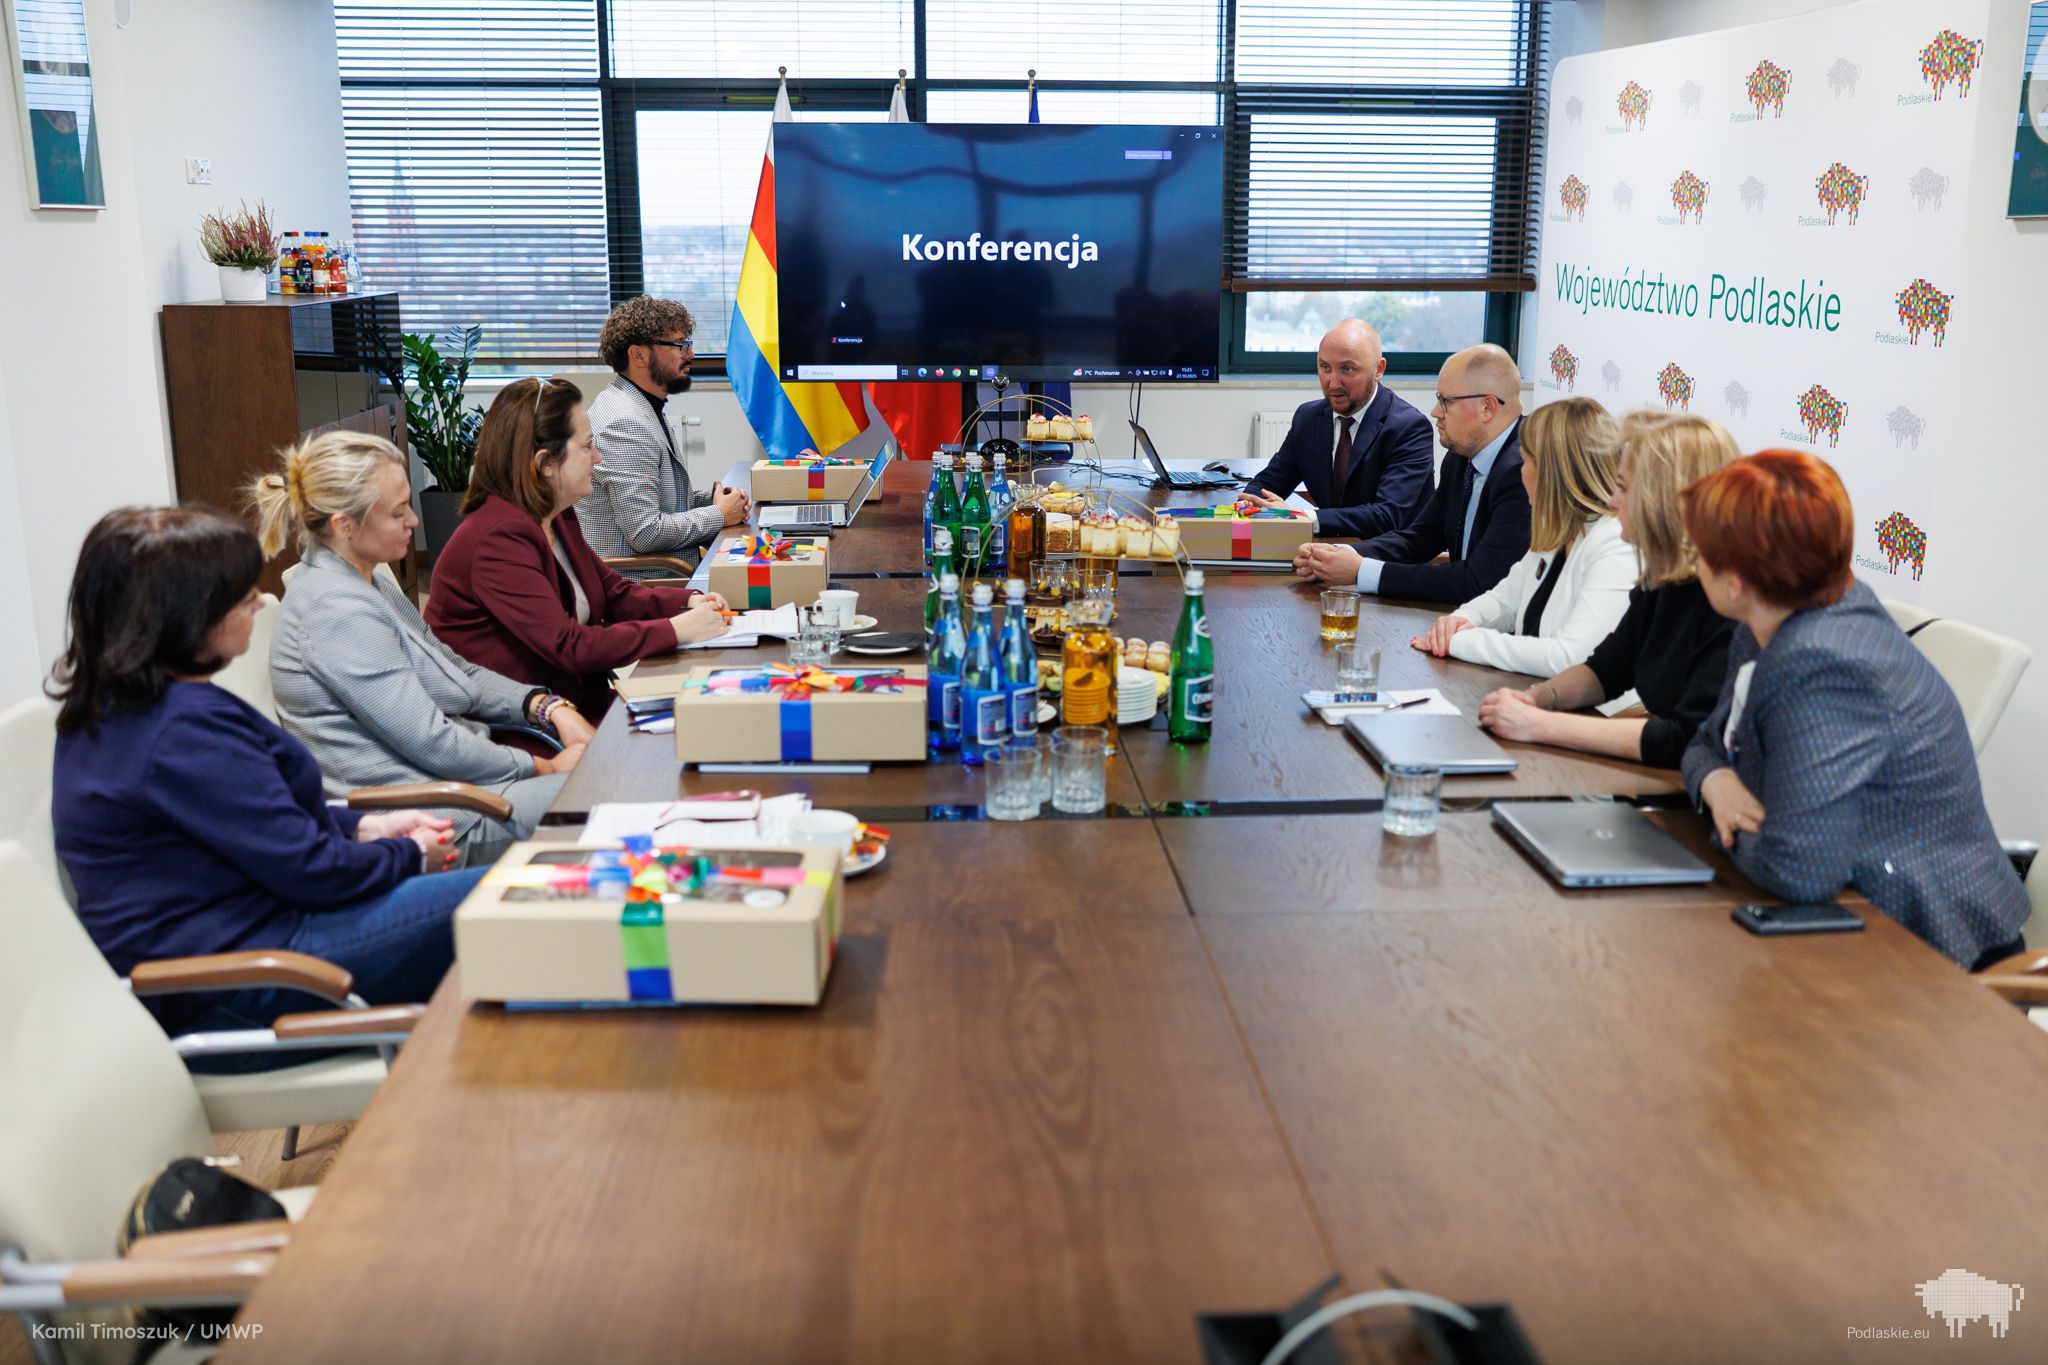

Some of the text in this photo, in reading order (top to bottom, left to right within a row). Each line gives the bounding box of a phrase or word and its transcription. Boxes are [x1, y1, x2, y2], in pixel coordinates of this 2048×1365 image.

[1897, 92, 1932, 106] Podlaskie
[1730, 112, 1756, 123] Podlaskie
[1797, 215, 1828, 227] Podlaskie
[902, 232, 1099, 269] Konferencja
[1556, 262, 1841, 332] Województwo Podlaskie
[1875, 331, 1909, 345] Podlaskie
[1780, 428, 1809, 443] Podlaskie
[1855, 554, 1889, 573] Podlaskie
